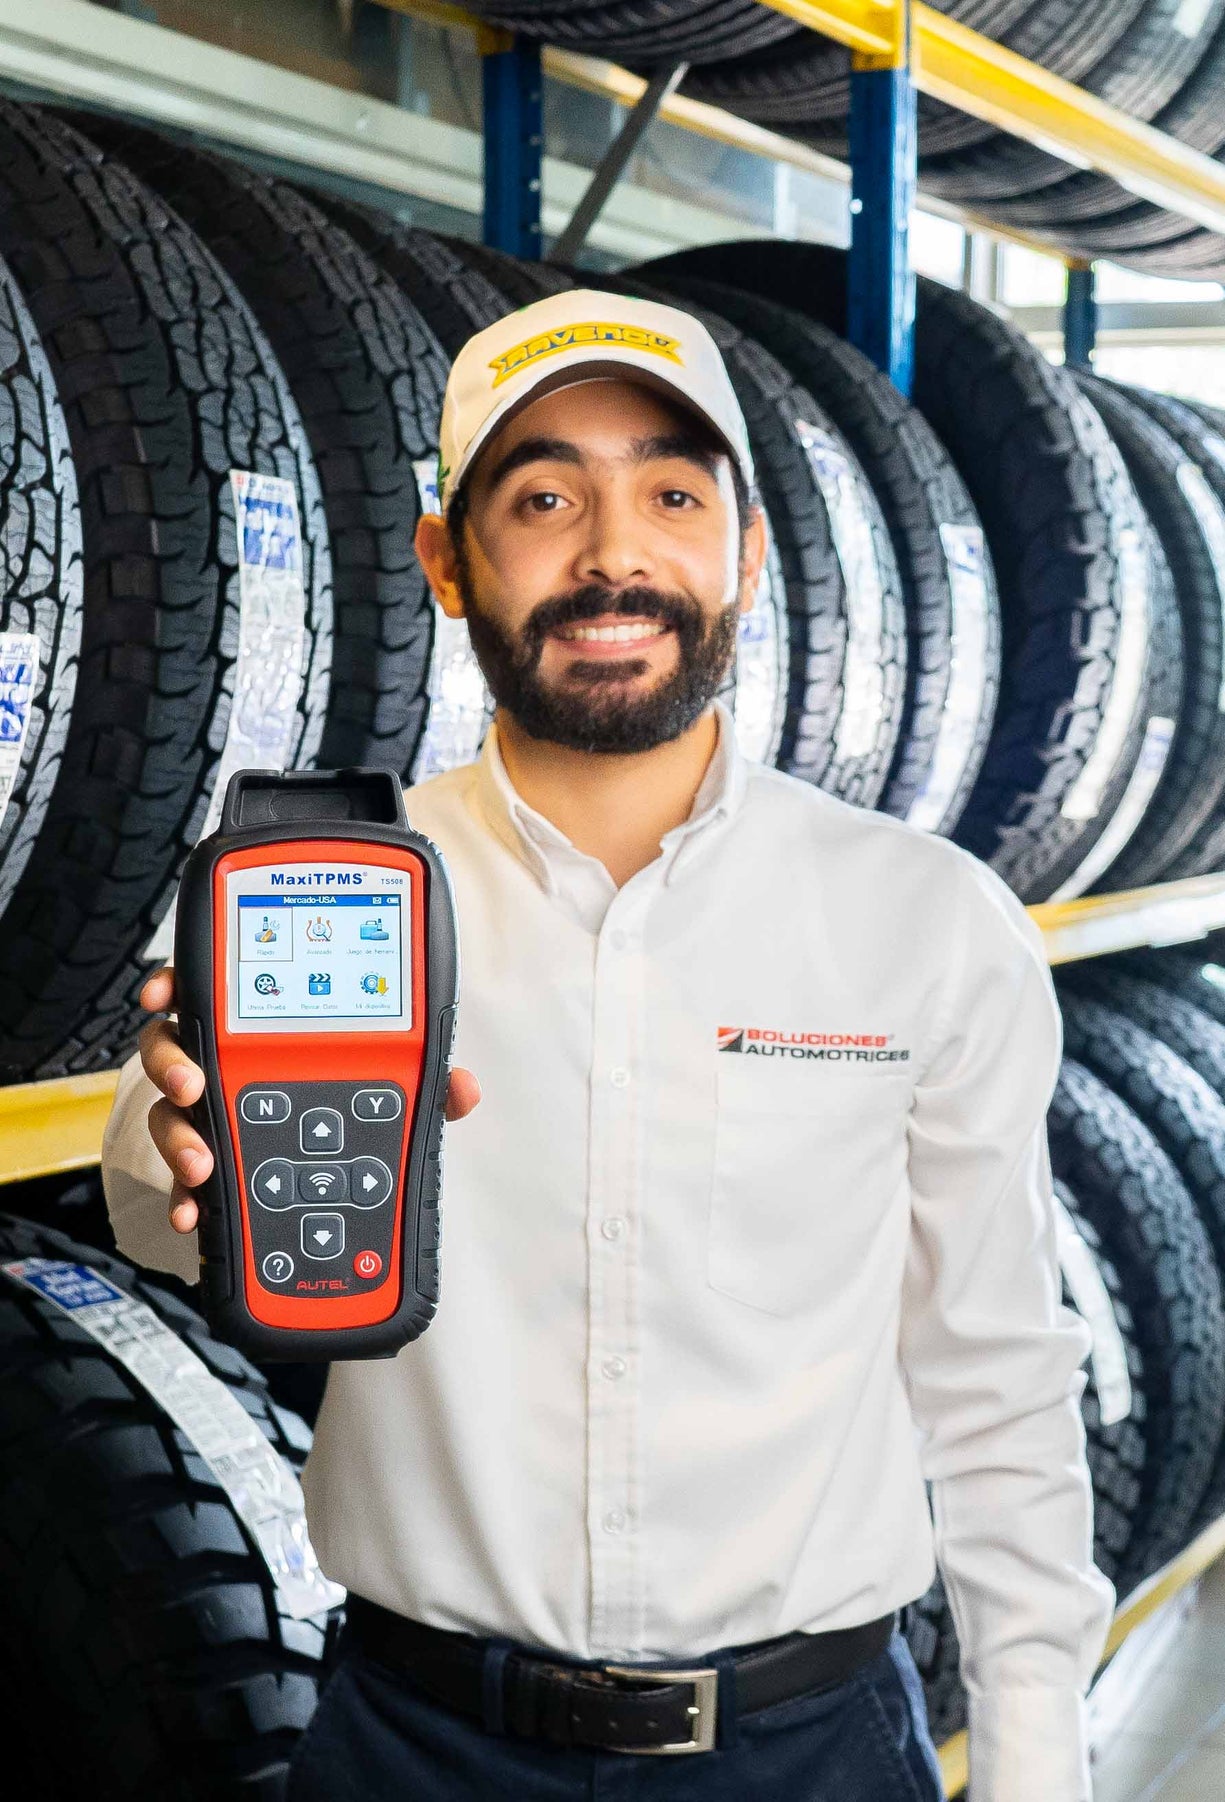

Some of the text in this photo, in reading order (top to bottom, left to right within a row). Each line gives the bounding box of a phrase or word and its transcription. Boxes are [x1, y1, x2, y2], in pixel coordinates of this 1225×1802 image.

[283, 896, 337, 905] Mercado-USA
[745, 1044, 910, 1062] AUTOMOTRICES
[259, 1099, 274, 1116] N
[368, 1096, 385, 1114] Y
[296, 1279, 349, 1291] AUTEL
